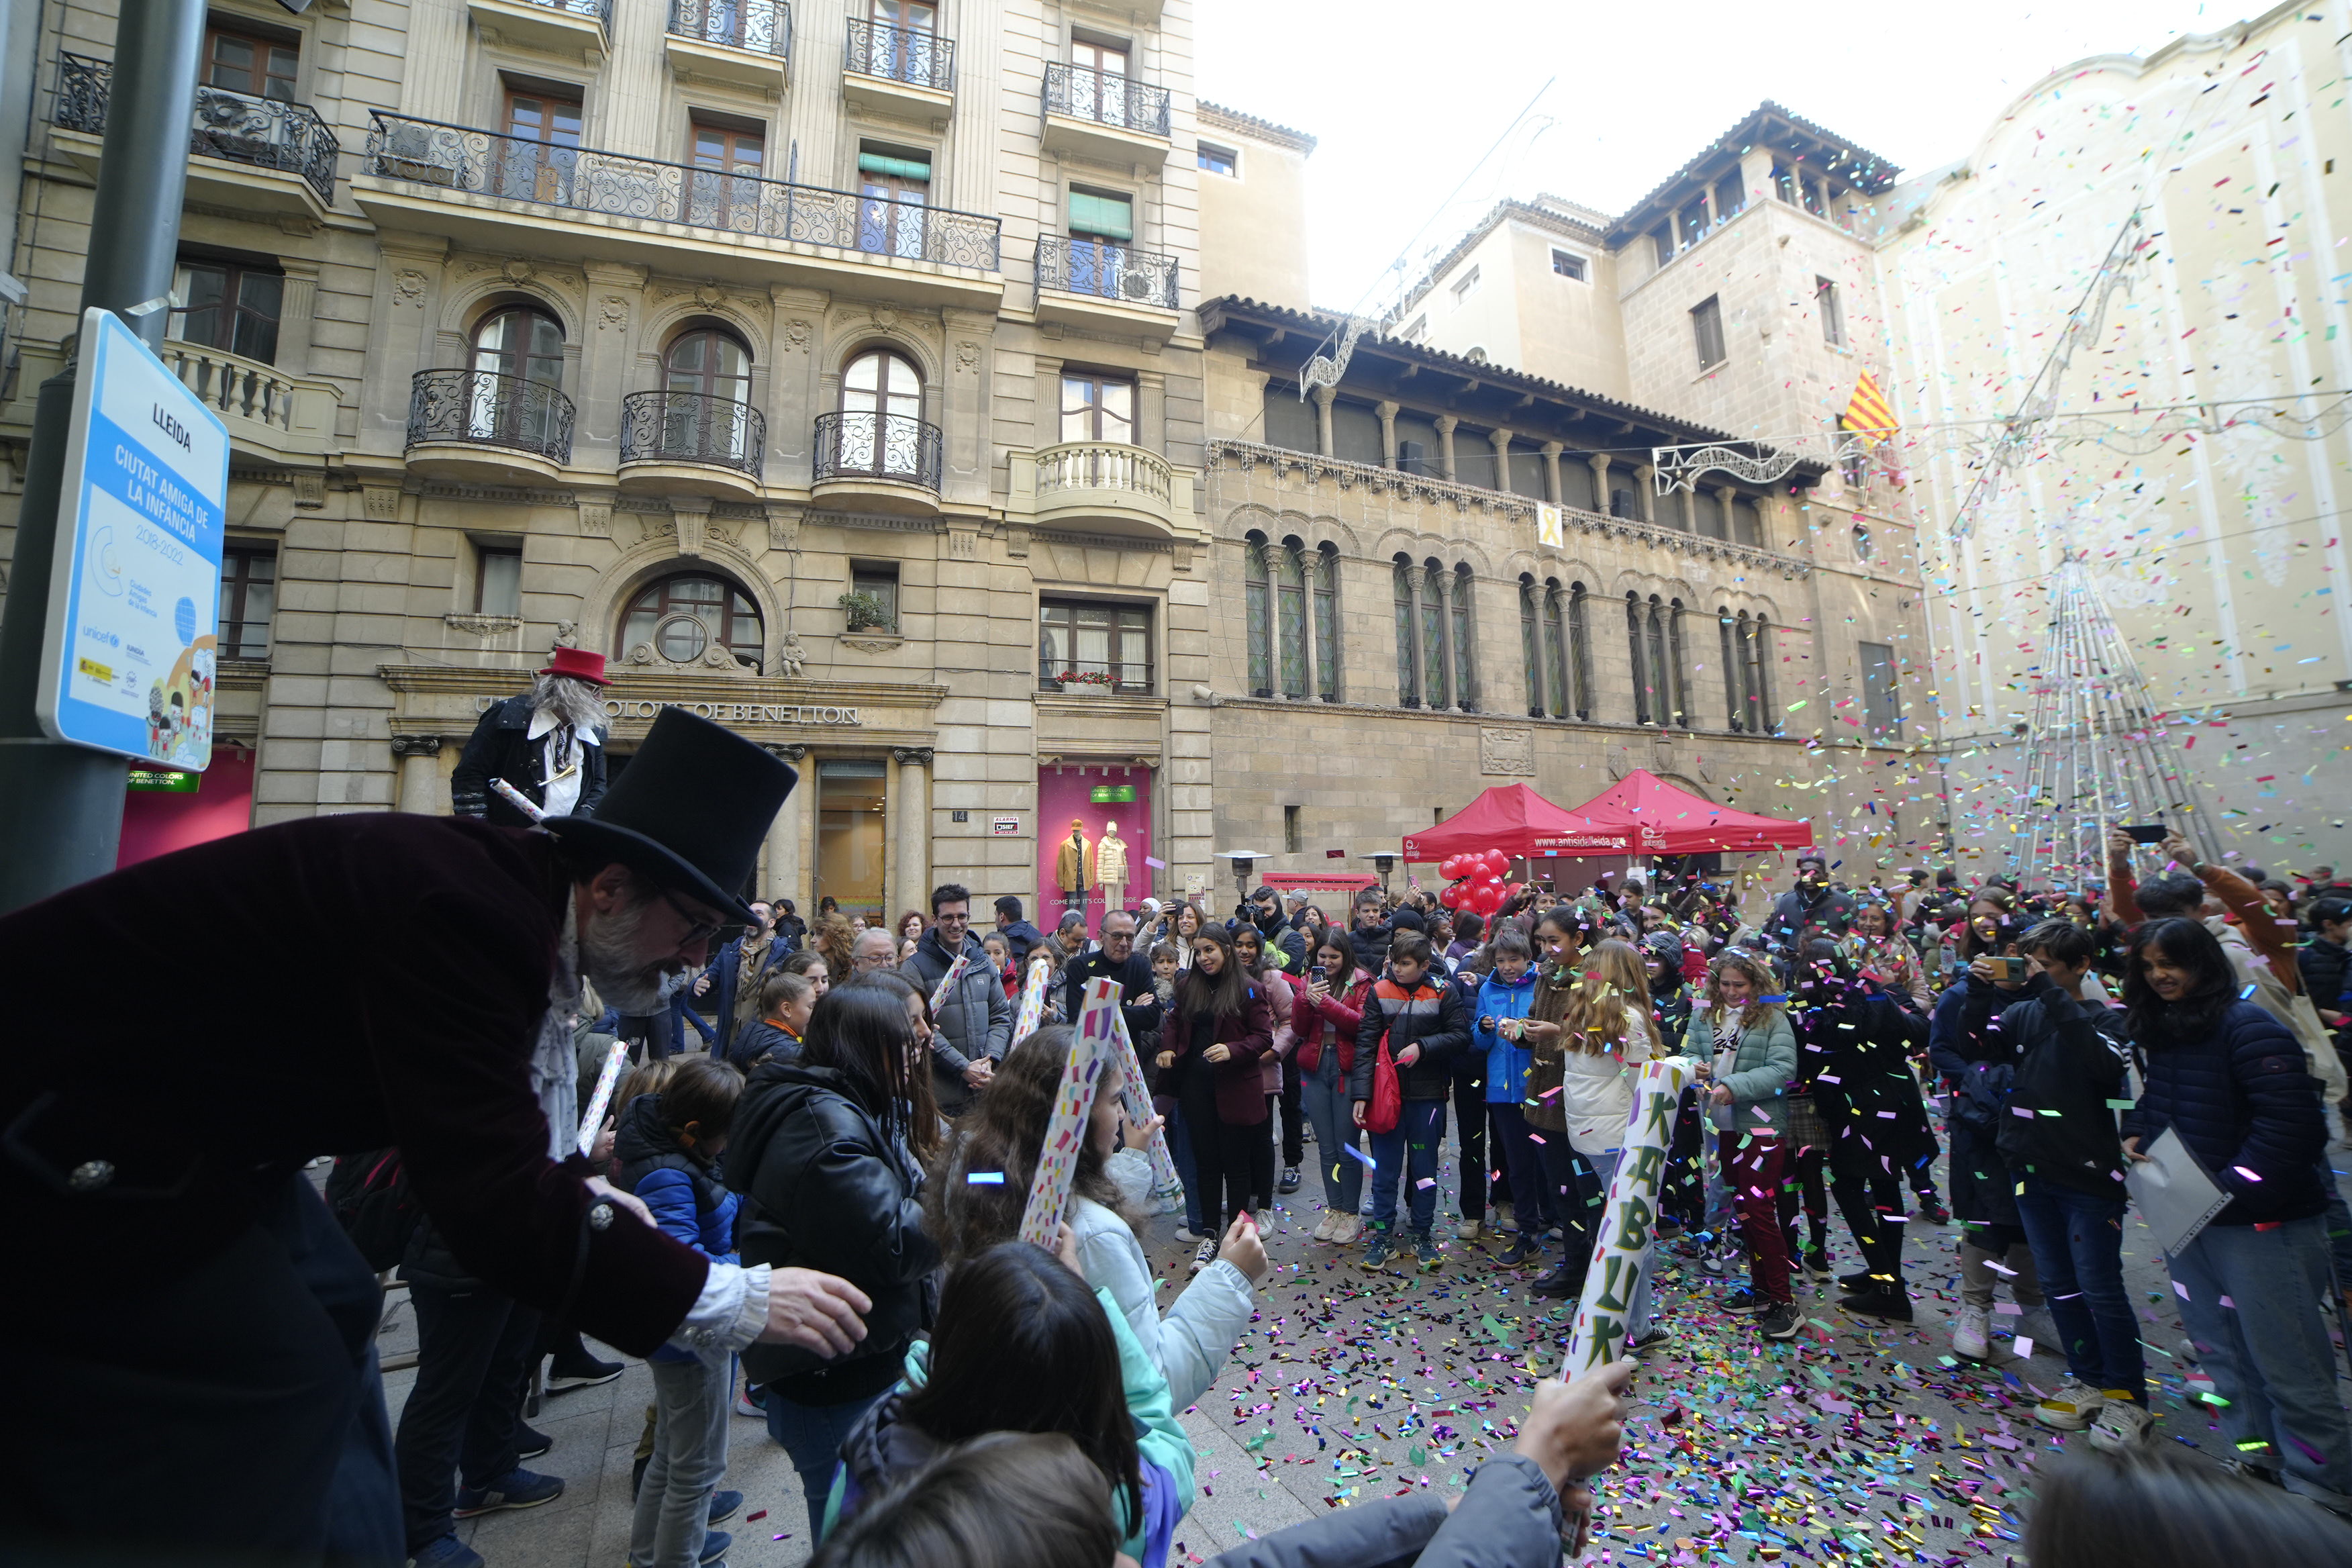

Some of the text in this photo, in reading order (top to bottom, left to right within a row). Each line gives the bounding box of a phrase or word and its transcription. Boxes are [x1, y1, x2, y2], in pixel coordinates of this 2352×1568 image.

[153, 403, 191, 453] LLEIDA
[115, 444, 208, 529] CIUTAT AMIGA DE
[128, 479, 196, 543] LA INFÀNCIA
[136, 524, 183, 565] 2018-2022
[83, 625, 110, 644] unicef
[604, 699, 863, 725] OLO OF BENETTON.
[954, 811, 965, 822] 14
